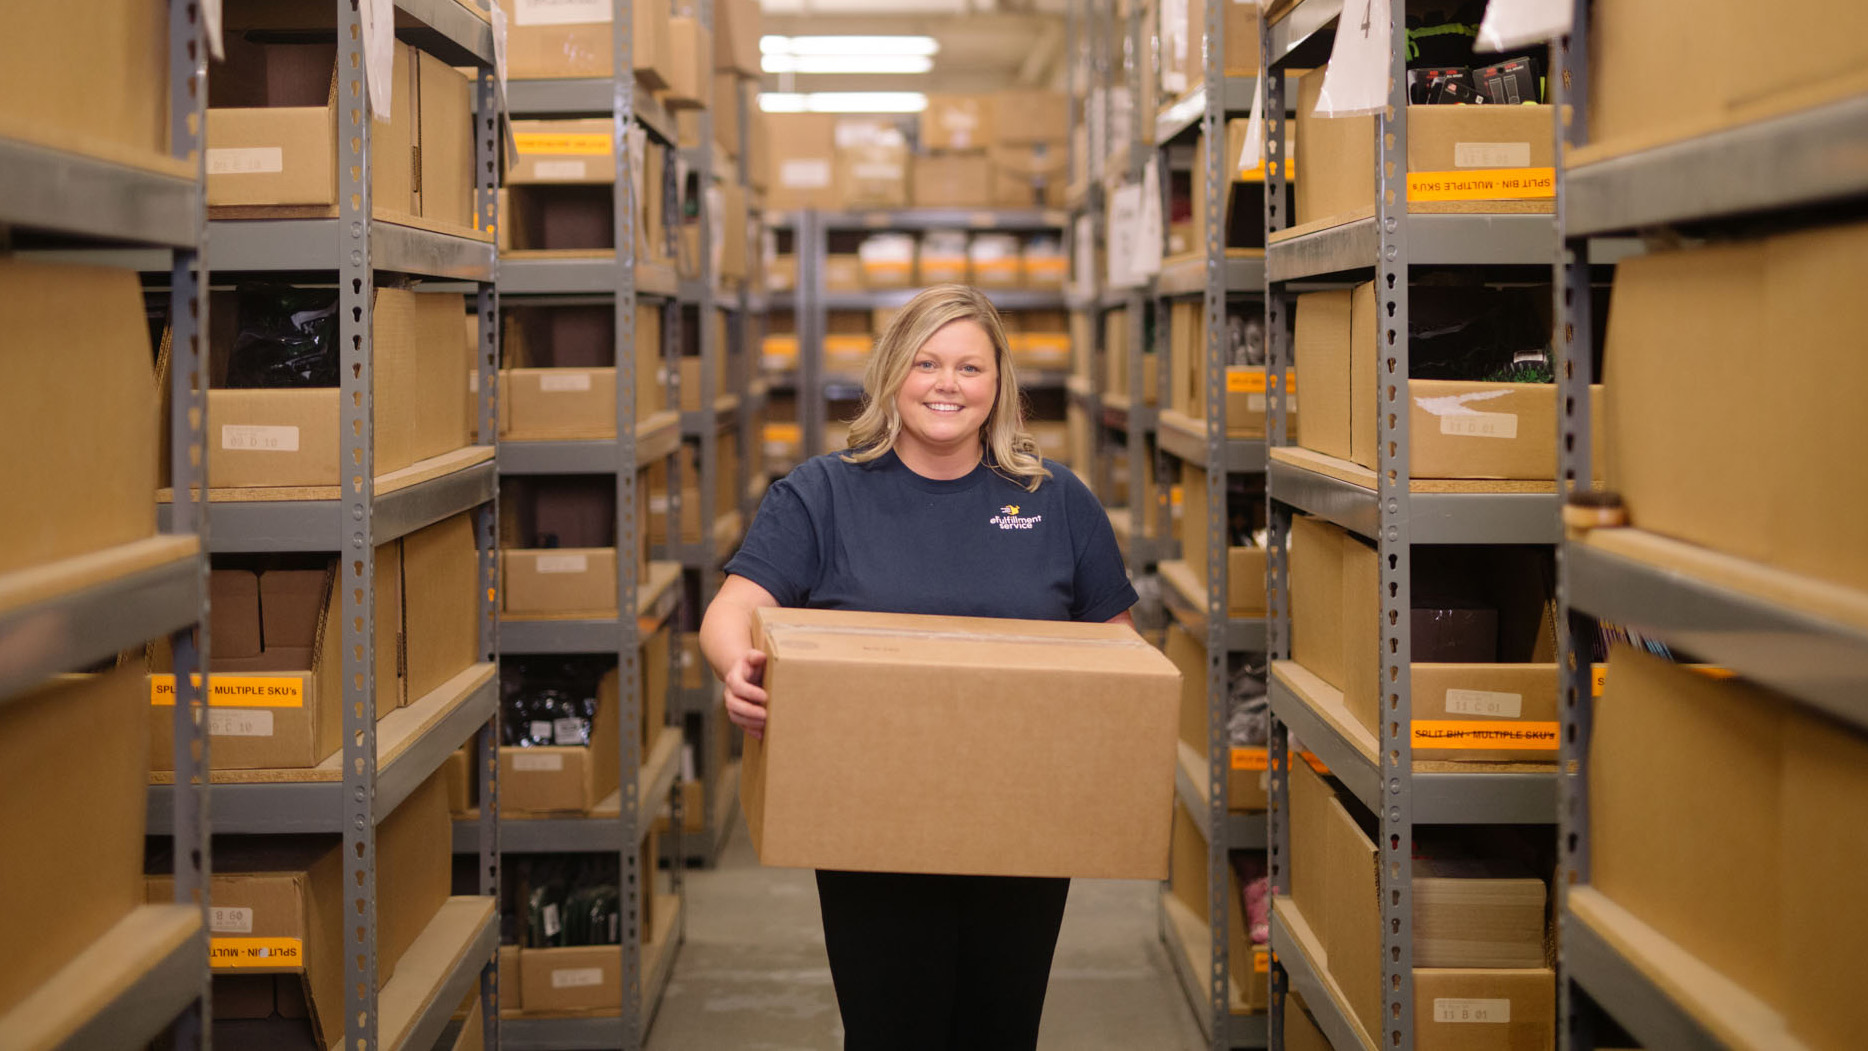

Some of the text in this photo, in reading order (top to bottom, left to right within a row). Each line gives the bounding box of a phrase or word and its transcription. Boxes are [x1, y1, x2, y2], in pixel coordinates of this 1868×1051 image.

[1444, 180, 1493, 191] MULTIPLE
[1502, 179, 1519, 189] BIN
[1522, 178, 1551, 188] SPLIT
[999, 522, 1033, 530] service
[156, 685, 176, 694] SPL
[214, 685, 264, 695] MULTIPLE
[267, 686, 297, 696] SKU's
[1415, 729, 1442, 739] SPLIT
[1472, 729, 1522, 740] MULTIPLE
[210, 948, 238, 957] MULT
[268, 948, 297, 957] SPLIT
